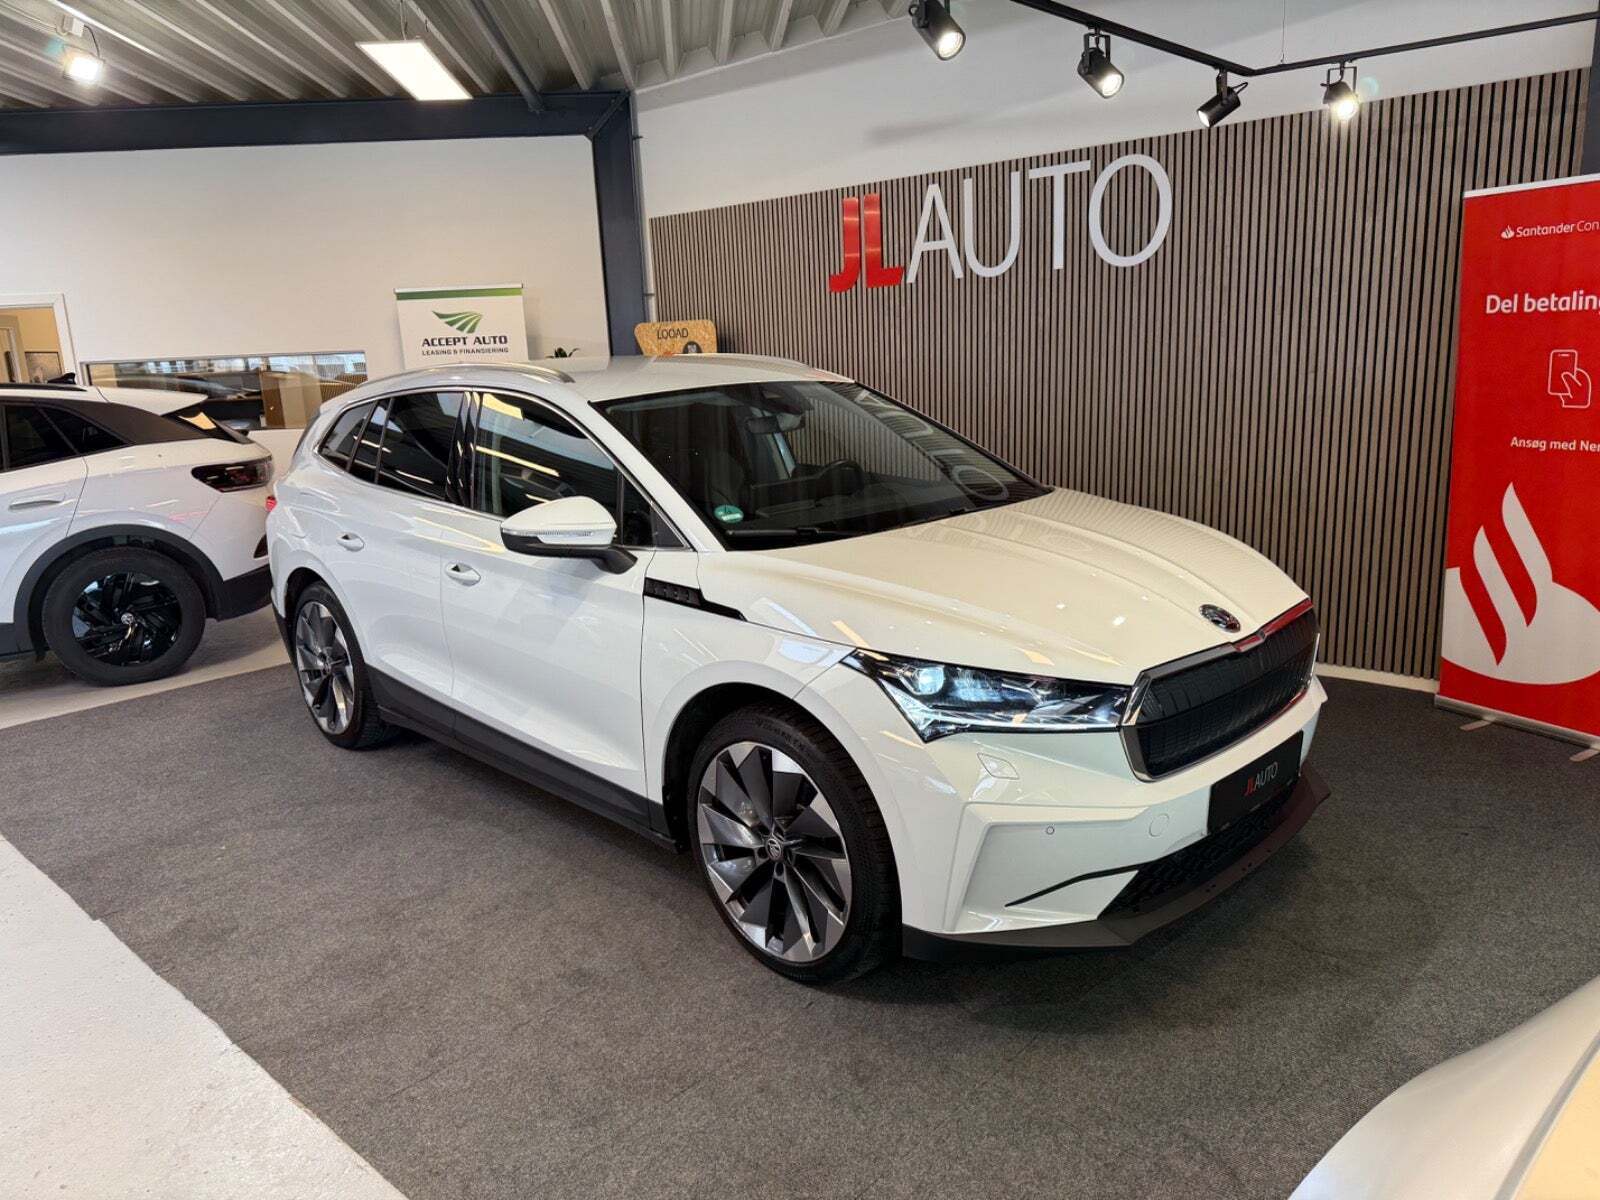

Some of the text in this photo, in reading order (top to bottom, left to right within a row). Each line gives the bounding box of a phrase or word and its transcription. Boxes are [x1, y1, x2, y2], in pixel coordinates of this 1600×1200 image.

[1516, 223, 1576, 237] Santander
[1486, 290, 1600, 315] Del betalin
[422, 335, 508, 347] ACCEPT AUTO
[459, 347, 508, 355] FINANSIERING
[1510, 436, 1547, 452] Ansøg
[1549, 440, 1576, 451] med
